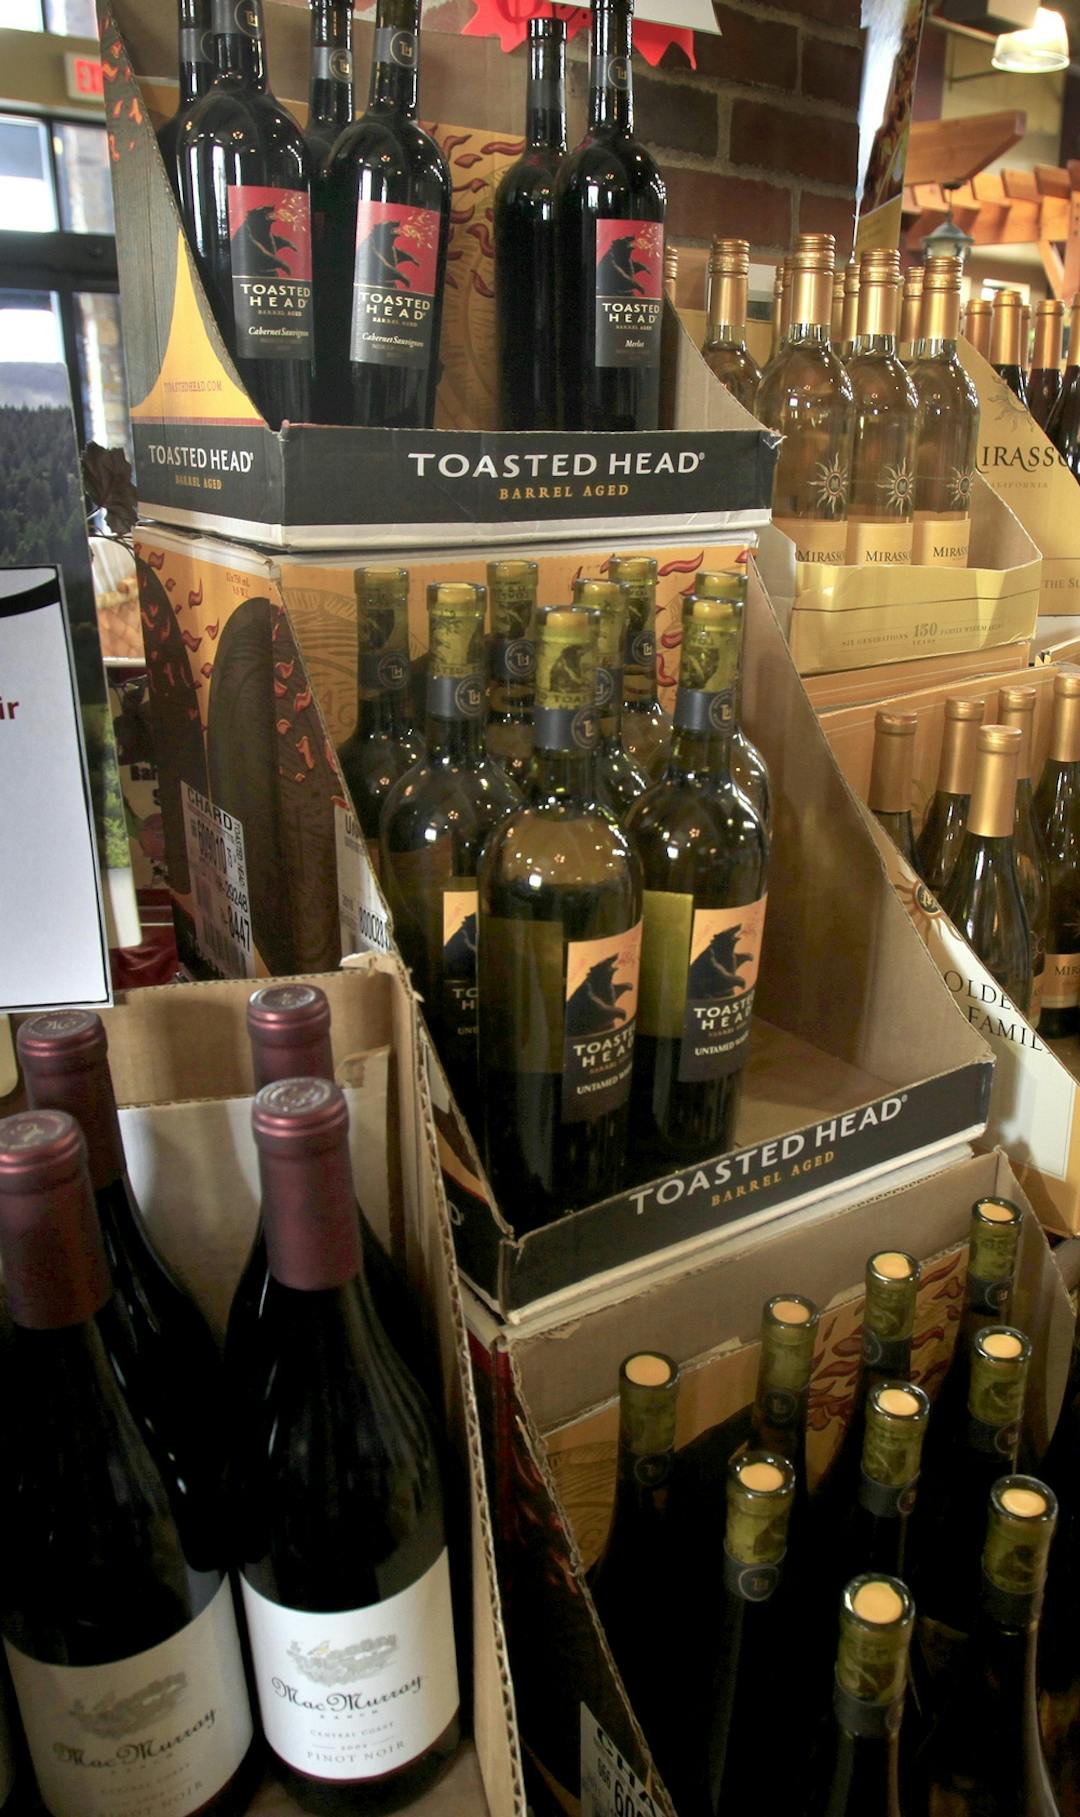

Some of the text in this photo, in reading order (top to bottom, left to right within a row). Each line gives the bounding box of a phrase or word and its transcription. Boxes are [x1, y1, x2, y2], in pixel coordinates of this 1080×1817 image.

[240, 284, 311, 298] TOASTED
[250, 296, 307, 308] HEAD
[361, 292, 430, 311] TOASTED
[602, 303, 660, 313] TOASTED
[366, 304, 426, 320] HEAD
[608, 313, 656, 323] HEAD
[248, 326, 281, 337] Cabernet
[362, 332, 392, 345] Cabernet
[625, 340, 645, 348] Merlot
[148, 445, 252, 473] TOASTED HEAD
[408, 452, 700, 478] TOASTED HEAD
[975, 446, 1069, 474] IRASS
[203, 478, 222, 490] AGED
[499, 484, 629, 501] BARREL AGED
[1043, 579, 1065, 589] THE
[913, 623, 937, 637] 150
[187, 787, 234, 832] CHARD
[694, 1041, 735, 1056] UNTAMED
[577, 1074, 618, 1095] UNTAMED
[629, 1097, 903, 1215] TOASTED HEAD
[711, 1151, 834, 1206] BARREL AGED
[310, 1721, 394, 1739] CENTRAL COAST
[307, 1740, 405, 1764] PINOT NOIR
